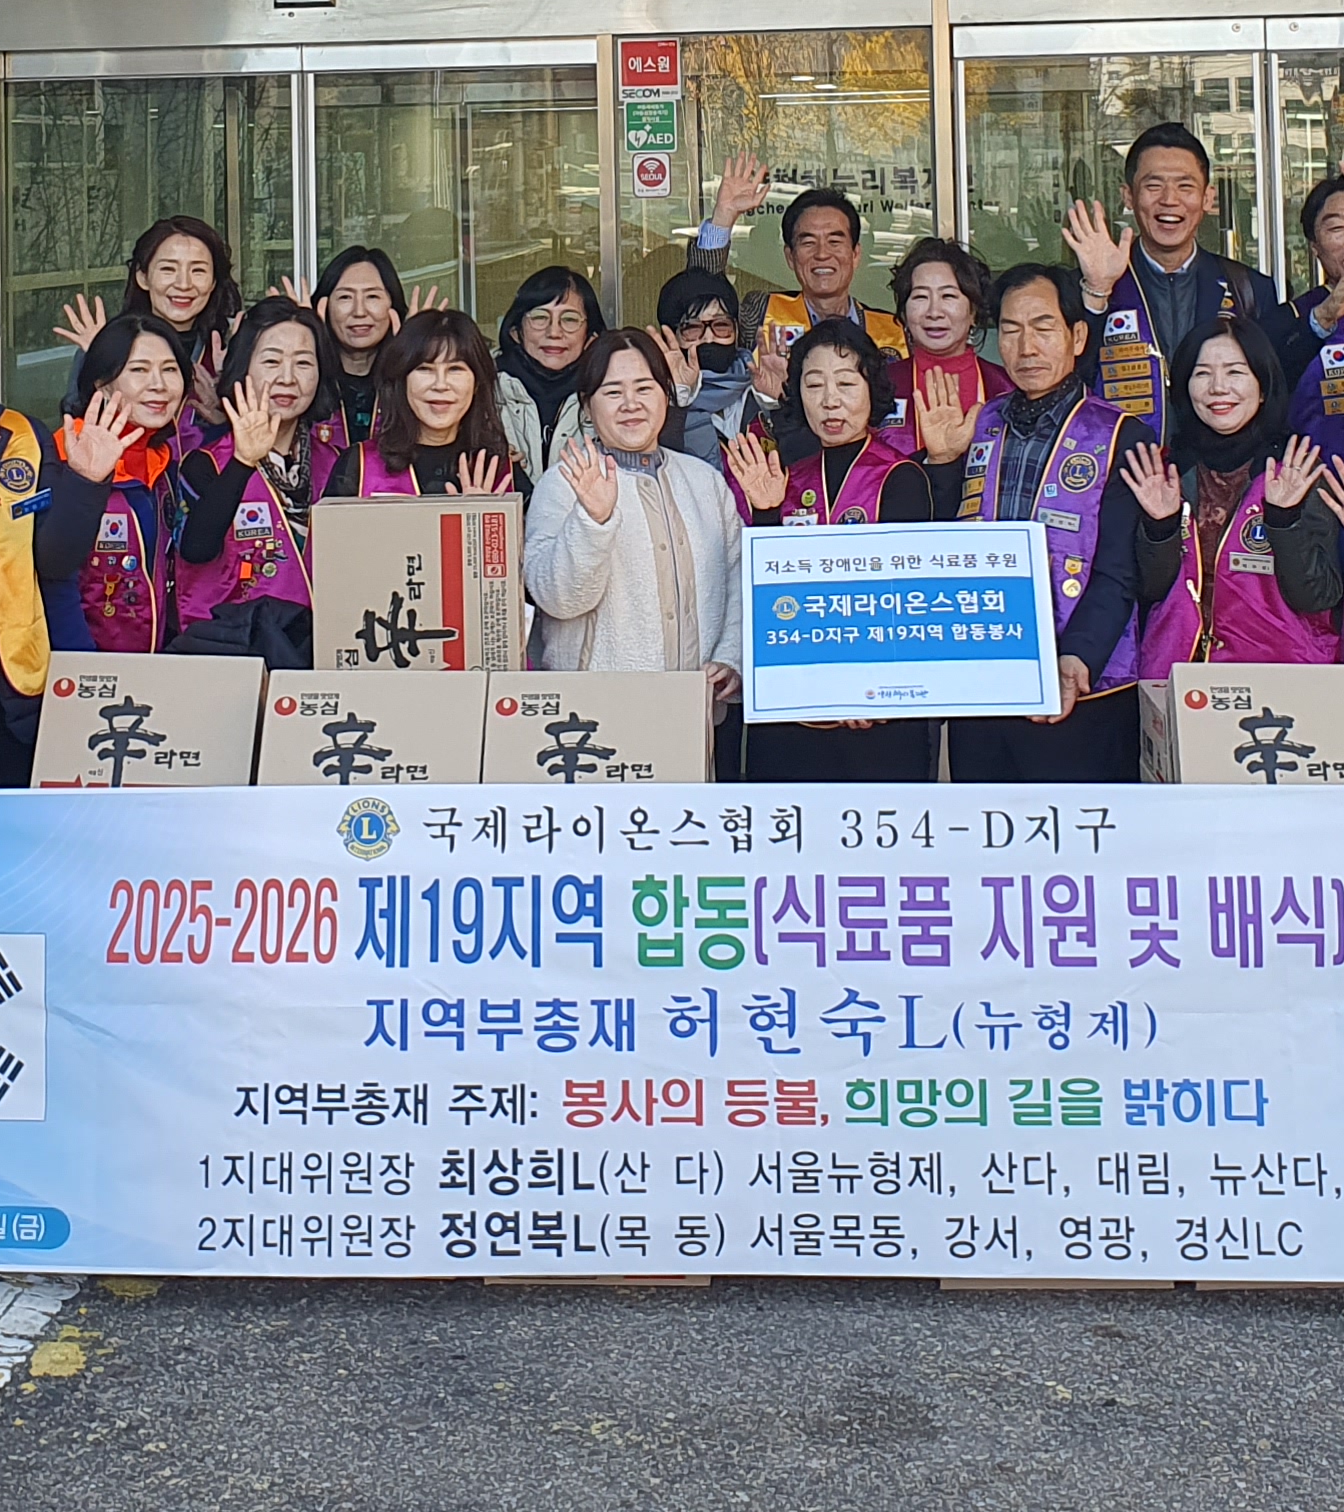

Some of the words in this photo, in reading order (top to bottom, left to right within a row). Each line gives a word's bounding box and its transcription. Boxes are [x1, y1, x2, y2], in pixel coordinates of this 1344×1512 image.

[628, 56, 670, 72] 에스원
[622, 88, 660, 98] SECOM
[647, 133, 673, 144] AED
[238, 528, 270, 538] KOREA
[764, 558, 813, 575] 저소득
[819, 556, 883, 574] 장애인을
[889, 554, 921, 570] 위한
[929, 553, 978, 569] 식료품
[985, 552, 1017, 568] 후원
[406, 554, 425, 601] 라면
[803, 589, 1006, 619] 국제라이온스협회
[356, 591, 457, 668] 辛
[766, 627, 860, 646] 354-D지구
[866, 625, 944, 643] 제19지역
[951, 623, 1023, 641] 합동봉사
[77, 683, 117, 699] 농심
[1210, 695, 1253, 710] 농심
[299, 701, 339, 716] 농심
[521, 701, 560, 716] 농심
[88, 695, 167, 787] 辛
[313, 712, 392, 785] 辛
[537, 712, 616, 783] 辛
[1234, 707, 1316, 784] 辛
[154, 749, 201, 769] 라면
[380, 764, 429, 783] 라면
[606, 762, 654, 782] 라면
[351, 800, 387, 813] LIONS
[360, 817, 377, 839] L
[423, 805, 804, 854] 국제라이온스협회
[840, 804, 1117, 854] 354-D지구
[106, 879, 338, 964] 2025-2026
[355, 874, 604, 968] 제19지역
[632, 873, 954, 970] 합동(식료품
[980, 874, 1098, 969] 지원
[1127, 875, 1181, 969] 및
[363, 997, 637, 1053] 지역부총재
[234, 1082, 429, 1126] 지역부총재
[448, 1082, 538, 1126] 주제:
[562, 1079, 705, 1128] 봉사의
[723, 1079, 829, 1128] 등불,
[844, 1078, 989, 1127] 희망의
[1007, 1078, 1103, 1127] 길을
[1123, 1078, 1269, 1127] 밝히다
[198, 1151, 416, 1196] 1지대위원장
[748, 1150, 957, 1198] 서울뉴형제,
[981, 1151, 1070, 1197] 산다,
[1097, 1151, 1185, 1197] 대림,
[1209, 1151, 1342, 1197] 뉴산다,
[12, 1213, 46, 1242] (금)
[197, 1214, 416, 1258] 2지대위원장
[749, 1213, 919, 1260] 서울목동,
[944, 1213, 1033, 1261] 강서,
[1059, 1213, 1148, 1261] 영광,
[1174, 1214, 1304, 1260] 경신LC
